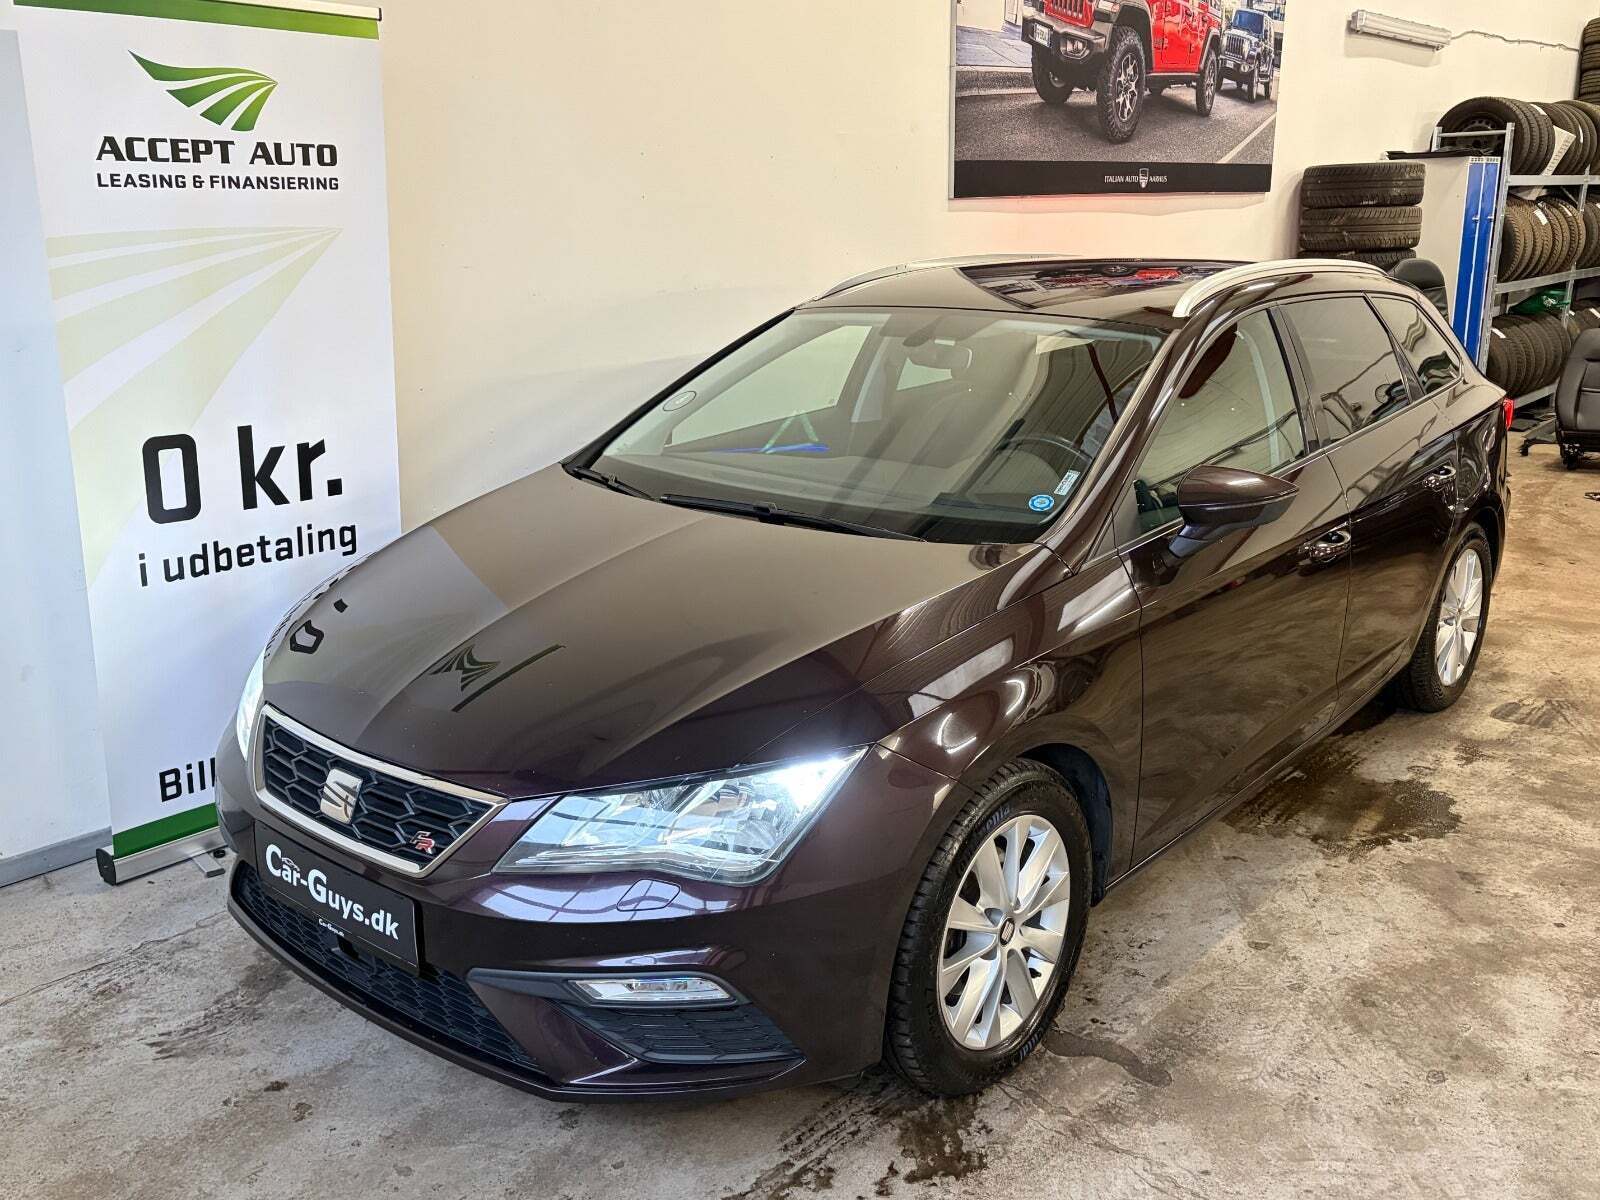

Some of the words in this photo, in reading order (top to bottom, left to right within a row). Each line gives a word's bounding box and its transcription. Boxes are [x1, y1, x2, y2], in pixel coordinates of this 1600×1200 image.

[96, 135, 236, 165] ACCEPT
[248, 141, 338, 167] AUTO
[96, 172, 187, 189] LEASING
[192, 174, 205, 190] &
[209, 175, 339, 191] FINANSIERING
[1125, 175, 1139, 183] AUTO
[237, 424, 343, 511] kr.
[138, 552, 148, 587] i
[163, 523, 357, 584] udbetaling
